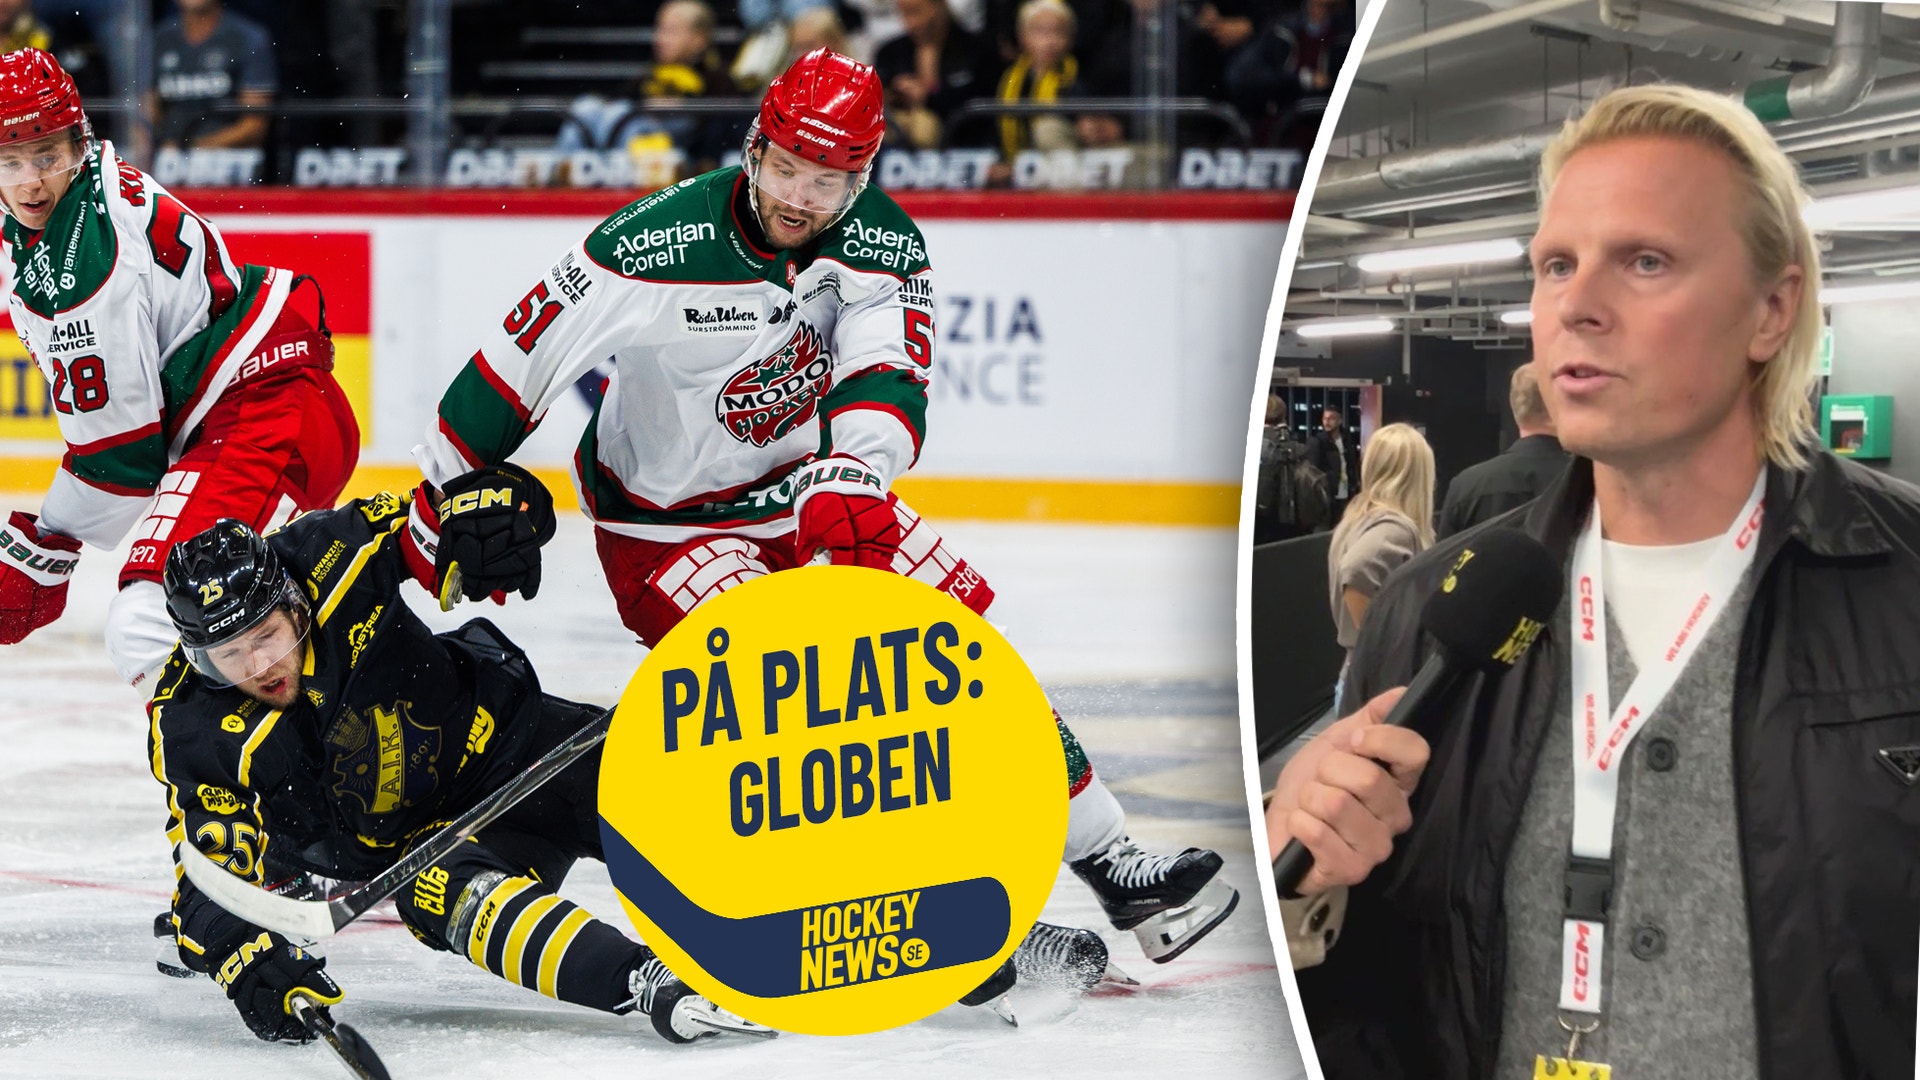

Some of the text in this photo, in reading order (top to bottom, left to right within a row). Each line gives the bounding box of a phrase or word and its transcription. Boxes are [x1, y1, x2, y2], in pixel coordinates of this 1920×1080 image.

[613, 221, 715, 259] Aderian
[622, 244, 688, 276] CoreIT
[503, 280, 565, 355] 51
[688, 324, 756, 333] SURSTRÖMMING
[903, 307, 936, 369] 5
[945, 296, 1043, 344] ZIA
[47, 337, 96, 353] ERVICE
[53, 354, 110, 415] 28
[723, 358, 828, 410] MODO
[736, 376, 825, 434] HOCKEY
[793, 465, 882, 498] AUER
[439, 488, 512, 525] CCM
[311, 539, 341, 578] ADVANZIA
[316, 542, 347, 583] INSURANCE
[198, 580, 223, 606] 25
[1580, 576, 1594, 641] CCM
[208, 608, 245, 633] CCM
[350, 605, 384, 669] INDUSTREA
[1598, 706, 1640, 771] CCM
[196, 821, 257, 878] 25
[426, 866, 449, 915] CLUB
[476, 901, 495, 942] CCM
[1573, 921, 1591, 1002] CCM
